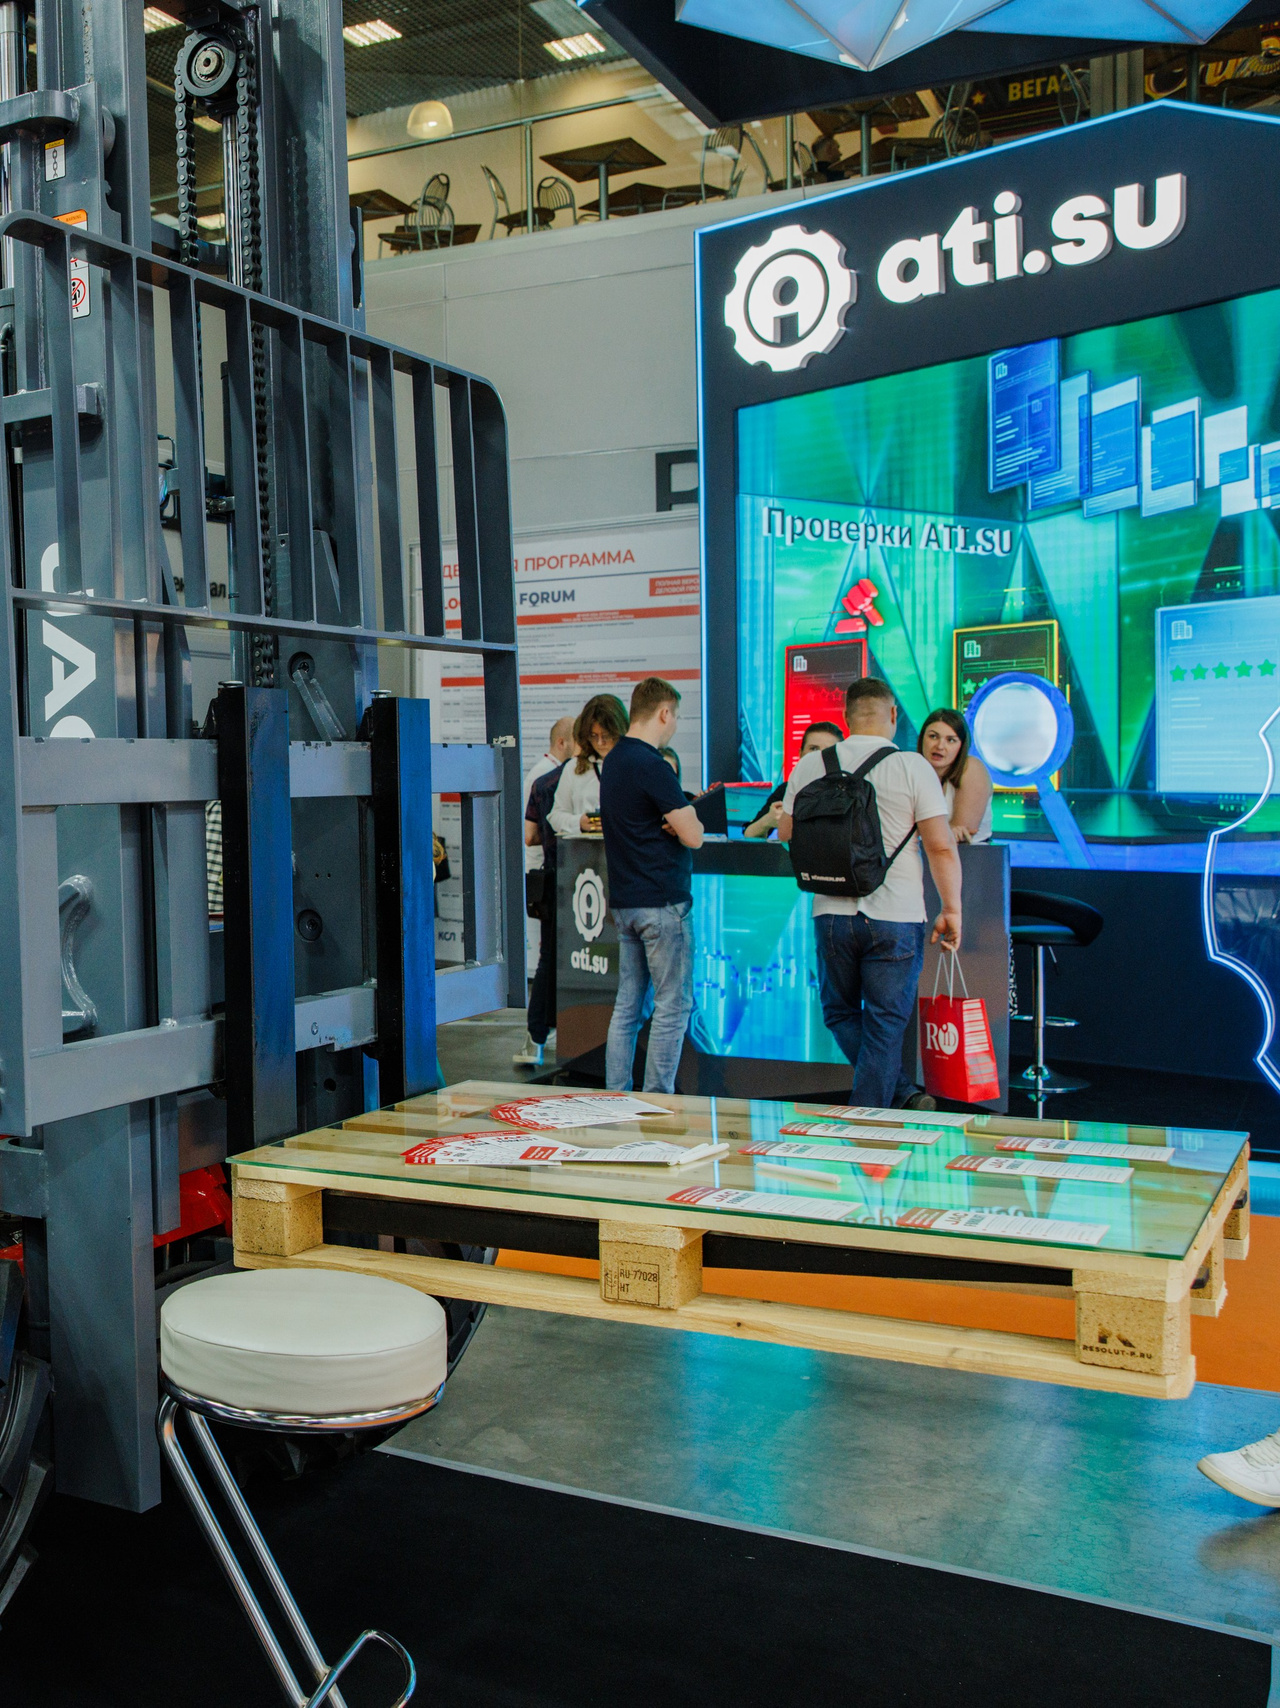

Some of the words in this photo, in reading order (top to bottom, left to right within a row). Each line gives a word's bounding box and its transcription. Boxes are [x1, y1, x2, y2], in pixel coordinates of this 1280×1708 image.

[877, 173, 1187, 304] ati.su
[762, 506, 912, 549] Проверки
[920, 521, 1013, 556] ATI.SU
[524, 548, 636, 572] ПРОГРАММА
[519, 589, 575, 607] FORUM
[571, 947, 608, 975] ati.su
[619, 1283, 630, 1293] HT
[1082, 1344, 1153, 1360] RESOLUT-P.RU
